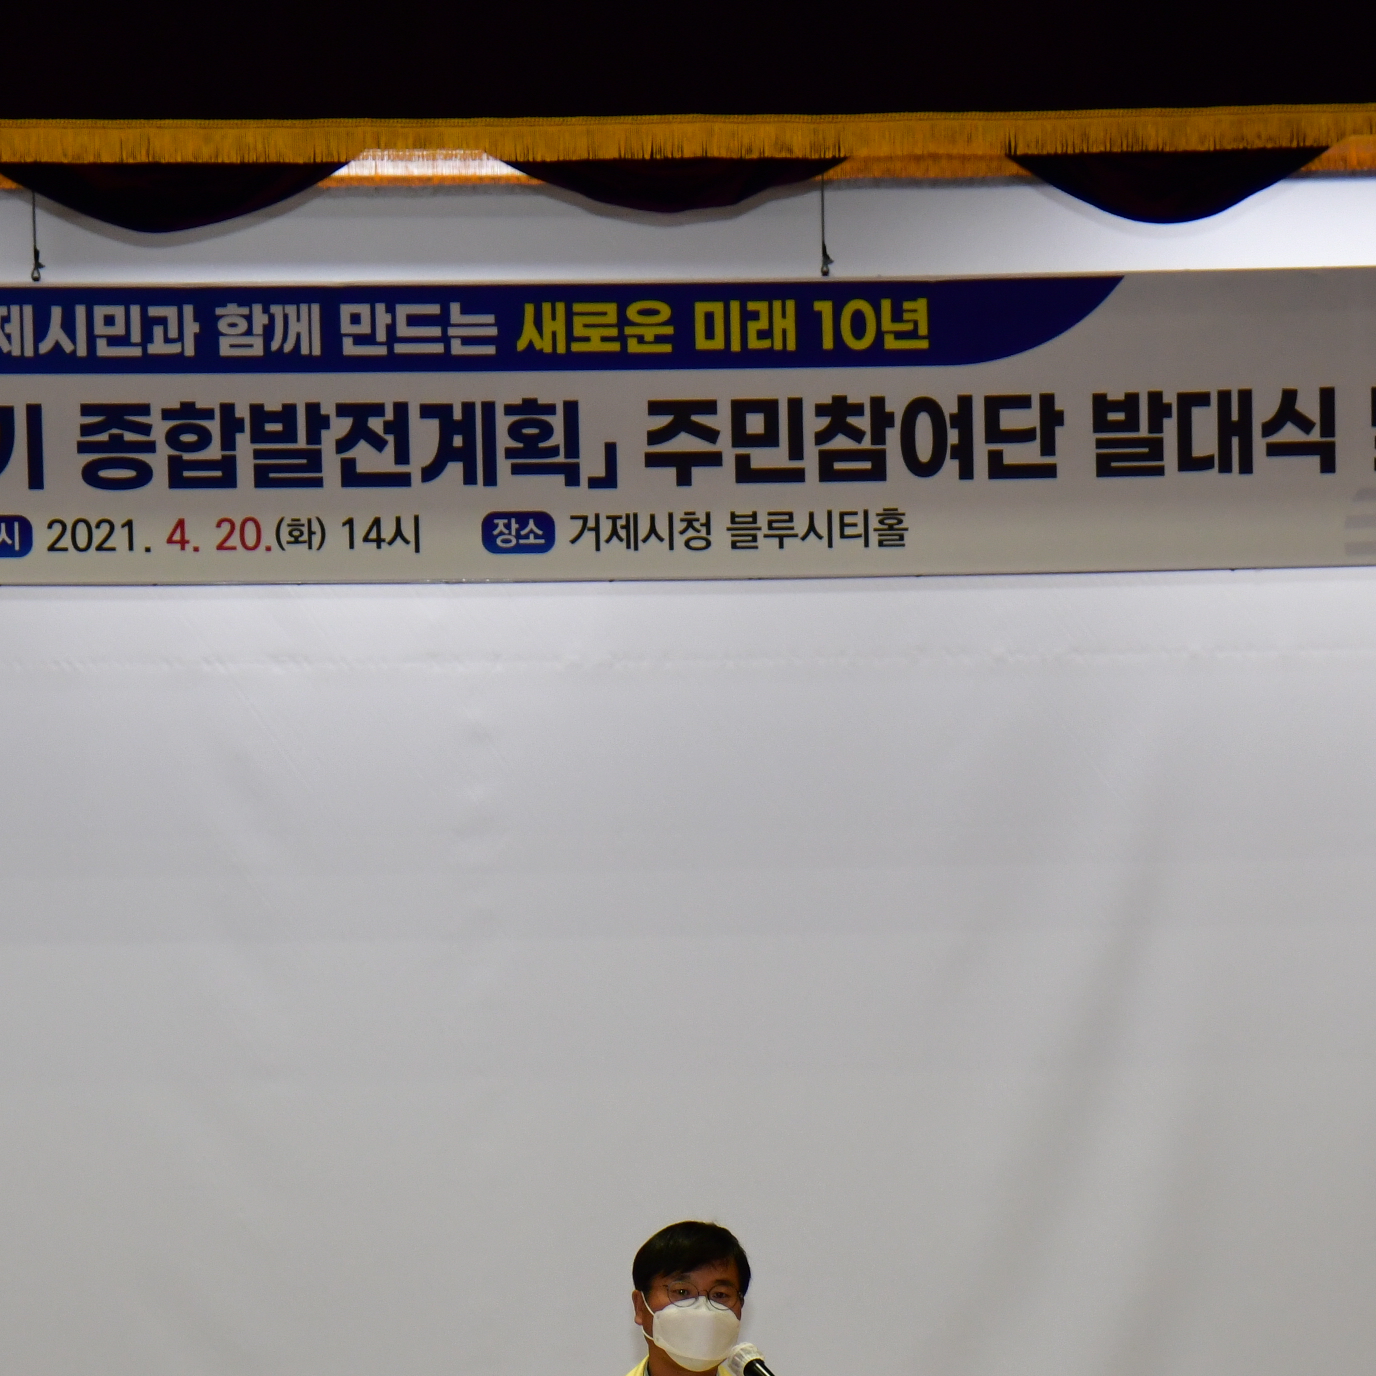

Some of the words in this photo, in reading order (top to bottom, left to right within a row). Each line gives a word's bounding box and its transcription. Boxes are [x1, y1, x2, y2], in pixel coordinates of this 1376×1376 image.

[215, 303, 322, 356] 함께
[340, 302, 499, 355] 만드는
[516, 301, 675, 354] 새로운
[693, 300, 797, 352] 미래
[814, 299, 929, 350] 10년
[75, 398, 618, 491] 종합발전계획」
[643, 393, 1065, 489] 주민참여단
[1090, 385, 1337, 478] 발대식
[46, 517, 152, 553] 2021.
[166, 517, 201, 553] 4.
[215, 516, 327, 552] 20.(화)
[341, 514, 421, 554] 14시
[492, 518, 546, 549] 장소
[569, 510, 712, 552] 거제시청
[725, 508, 909, 550] 블루시티홀
